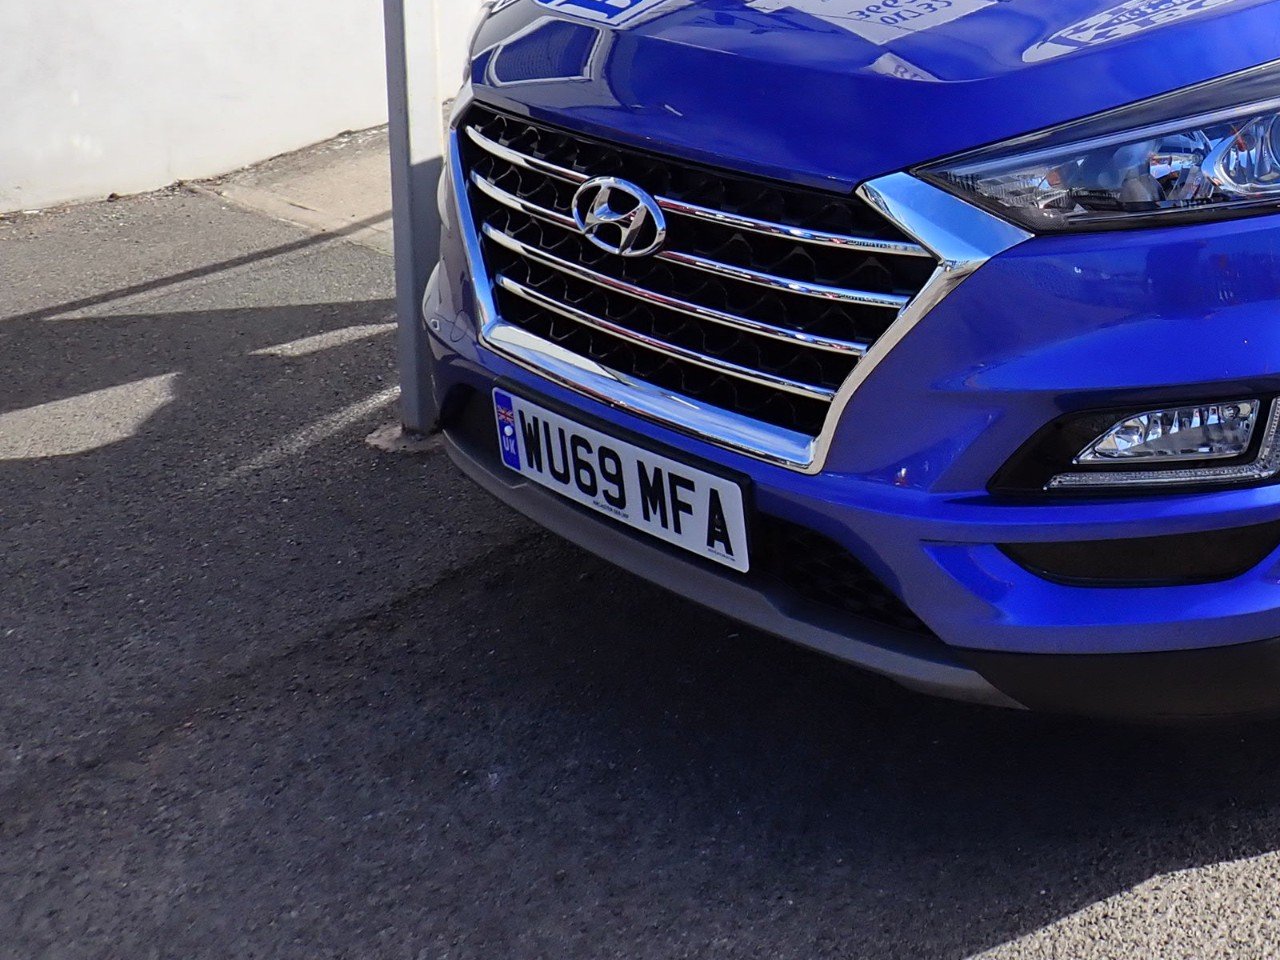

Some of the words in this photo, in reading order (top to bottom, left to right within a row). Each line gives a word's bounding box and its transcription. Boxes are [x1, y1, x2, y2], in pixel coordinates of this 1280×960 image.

[502, 435, 517, 456] UK
[518, 409, 628, 511] WU69
[636, 459, 734, 558] MFA
